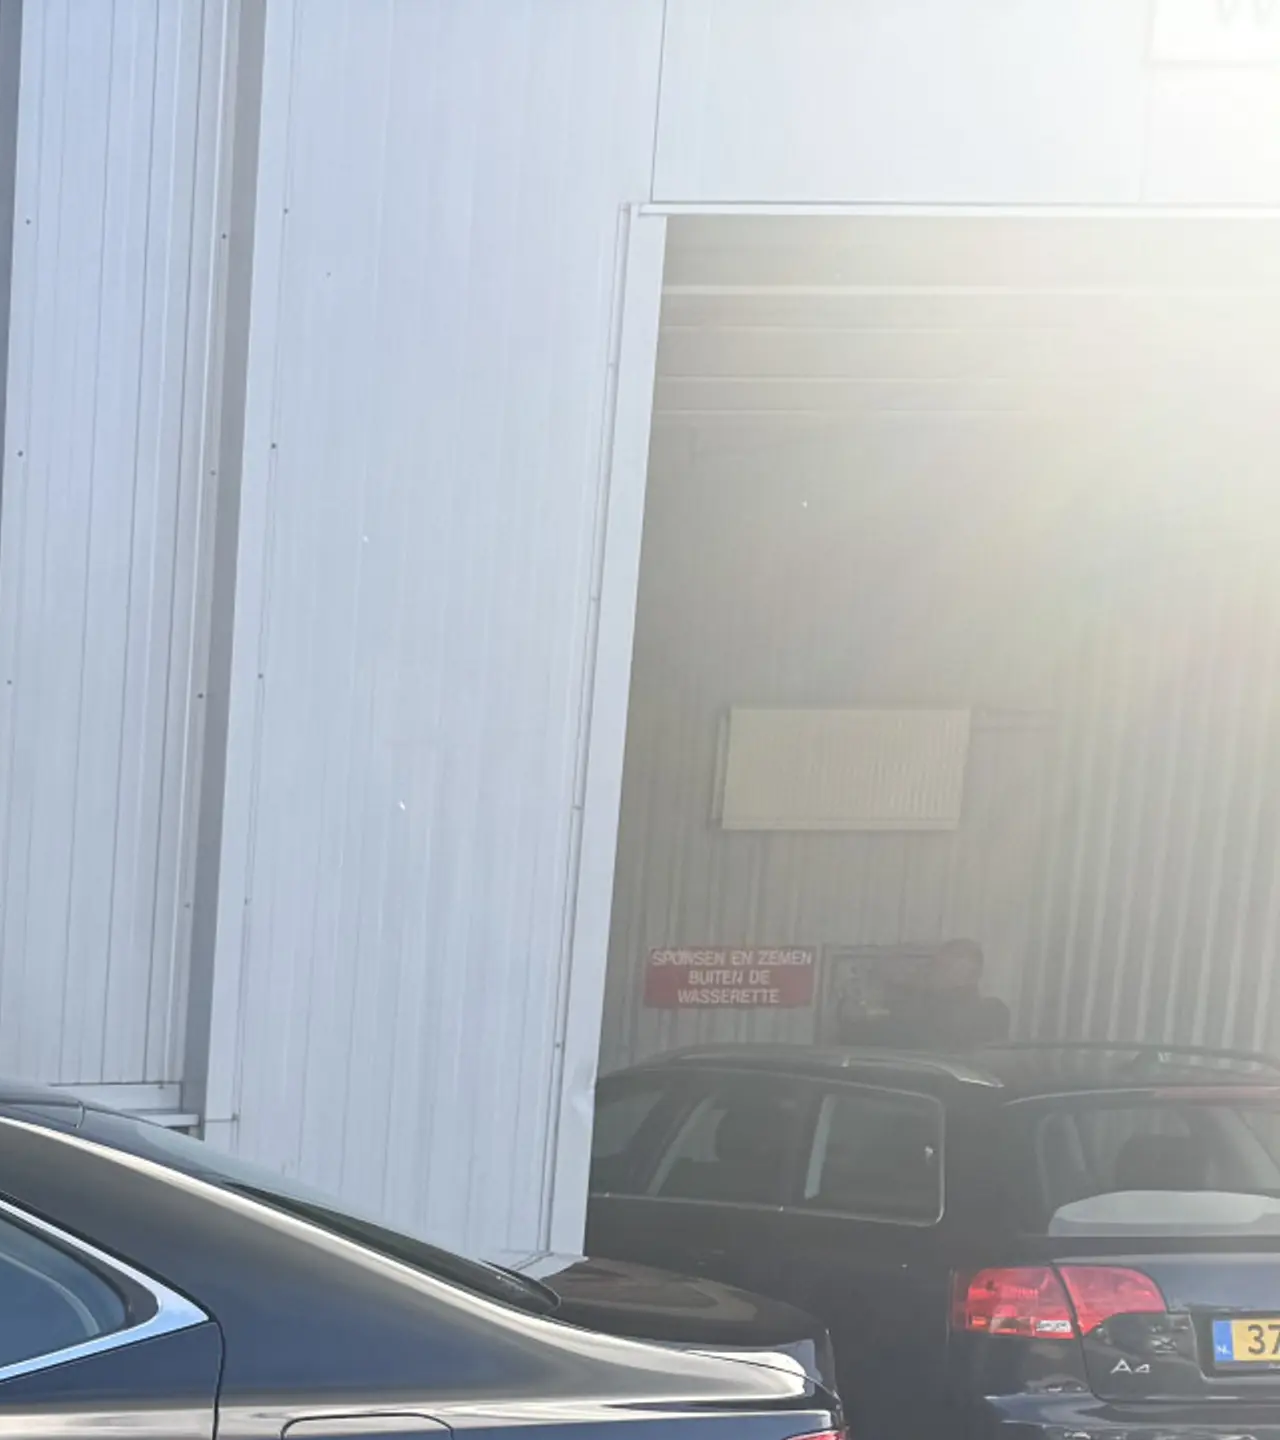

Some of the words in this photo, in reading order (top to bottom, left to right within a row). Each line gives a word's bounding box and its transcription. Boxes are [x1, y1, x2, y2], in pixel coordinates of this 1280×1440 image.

[732, 950, 752, 966] EN
[758, 949, 813, 966] ZEMEN
[687, 970, 743, 986] BUITEN
[749, 970, 772, 985] DE
[678, 988, 781, 1004] WASSERETTE
[1109, 1357, 1151, 1374] A4
